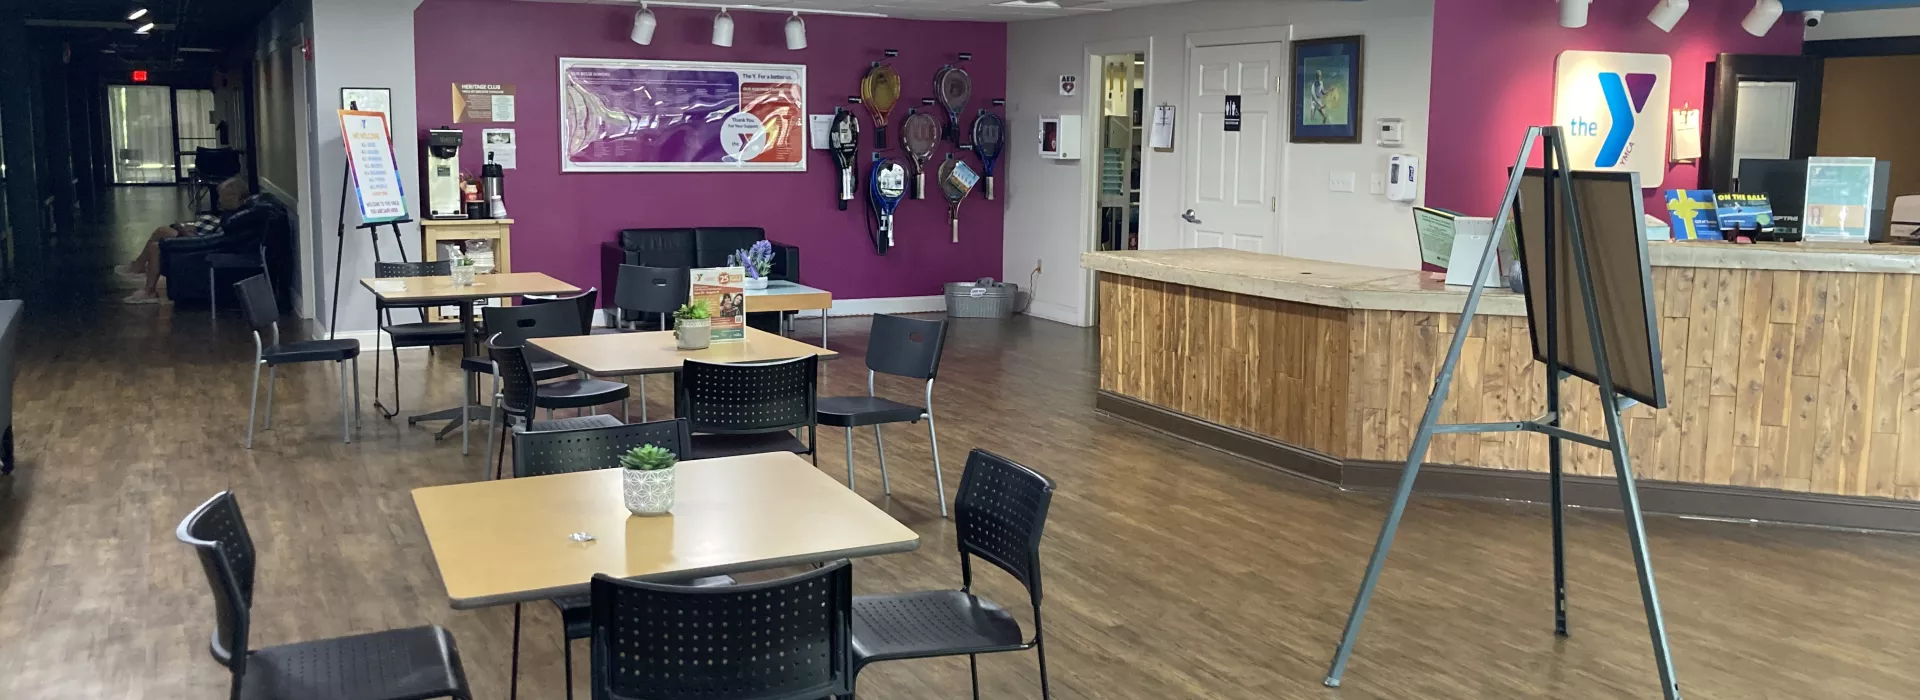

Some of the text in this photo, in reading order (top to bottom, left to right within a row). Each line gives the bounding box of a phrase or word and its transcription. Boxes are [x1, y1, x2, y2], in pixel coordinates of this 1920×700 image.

[1570, 116, 1598, 136] the
[1620, 142, 1635, 165] YMCA
[720, 275, 729, 283] 25
